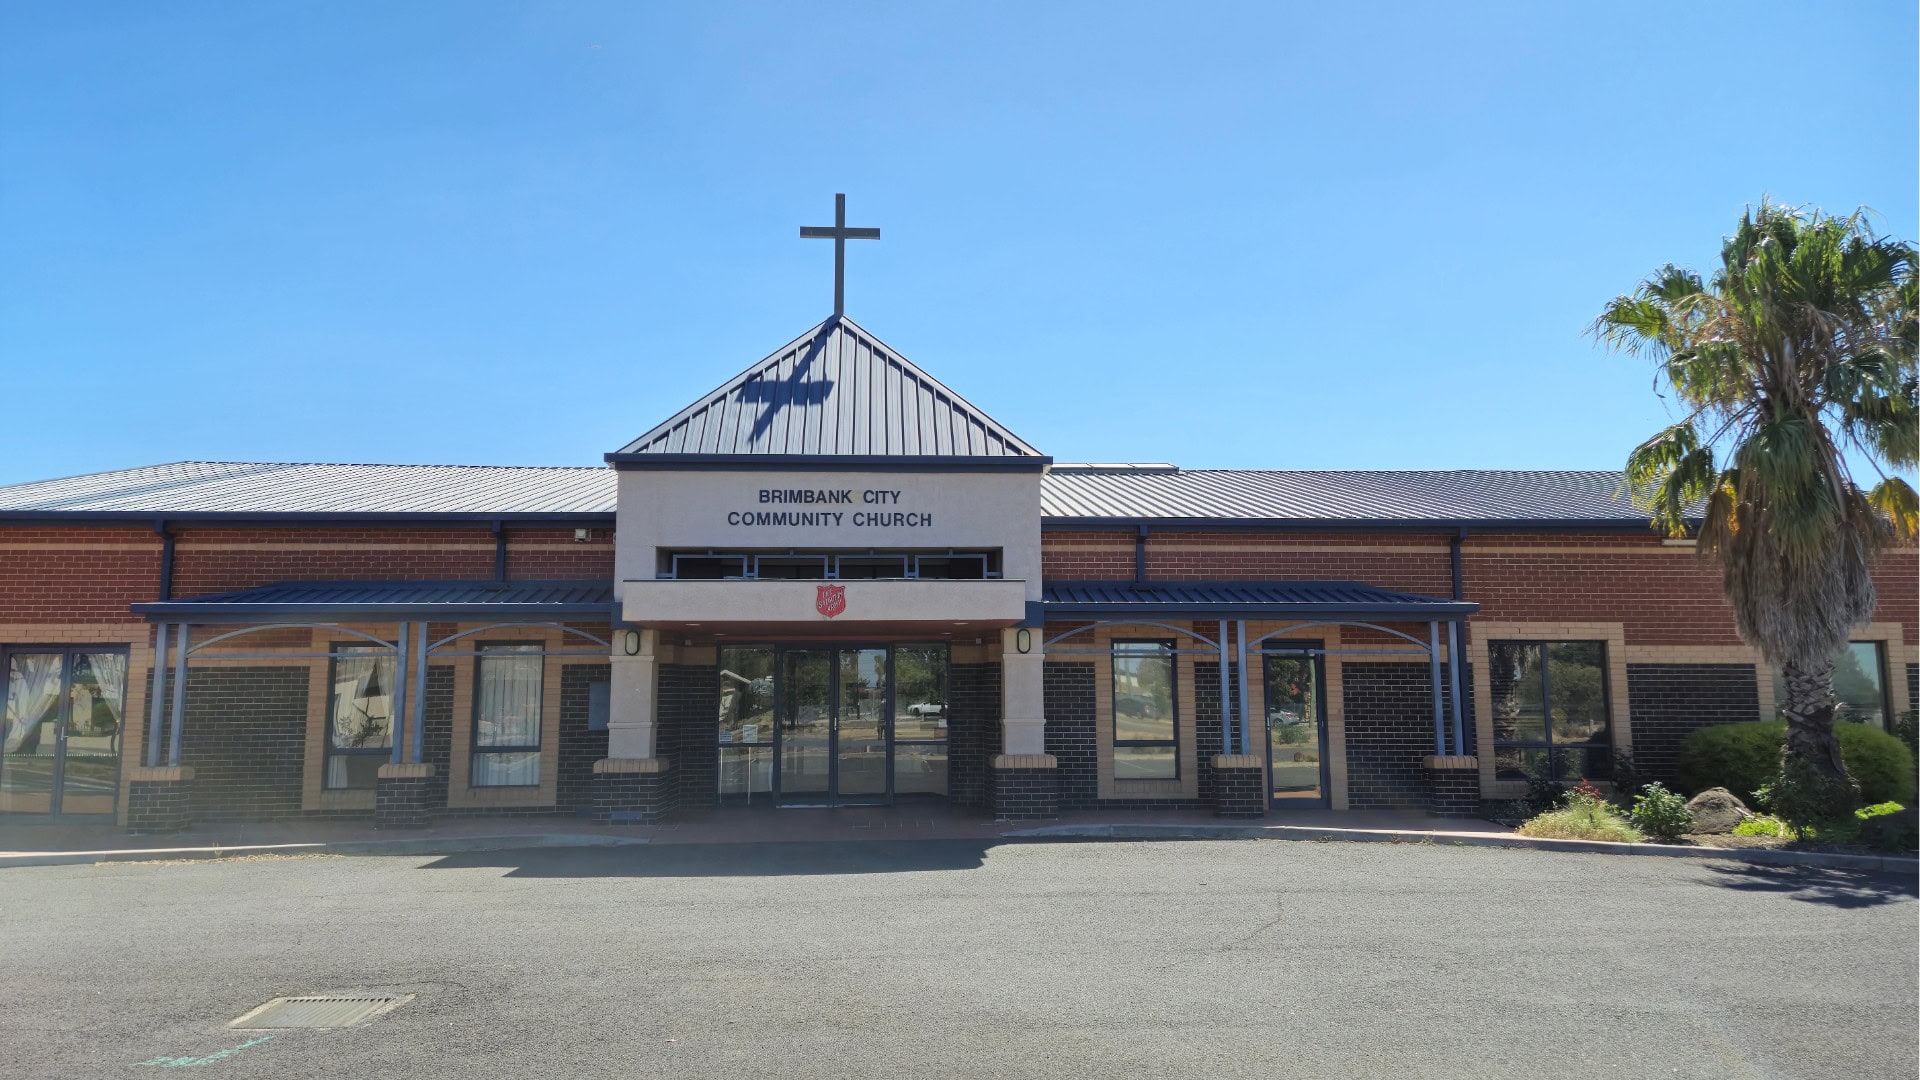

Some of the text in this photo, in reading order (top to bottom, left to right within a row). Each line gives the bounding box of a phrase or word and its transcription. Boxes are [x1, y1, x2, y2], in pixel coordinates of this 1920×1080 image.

[758, 489, 902, 505] BRIMBANK CITY
[727, 511, 932, 528] COMMUNITY CHURCH
